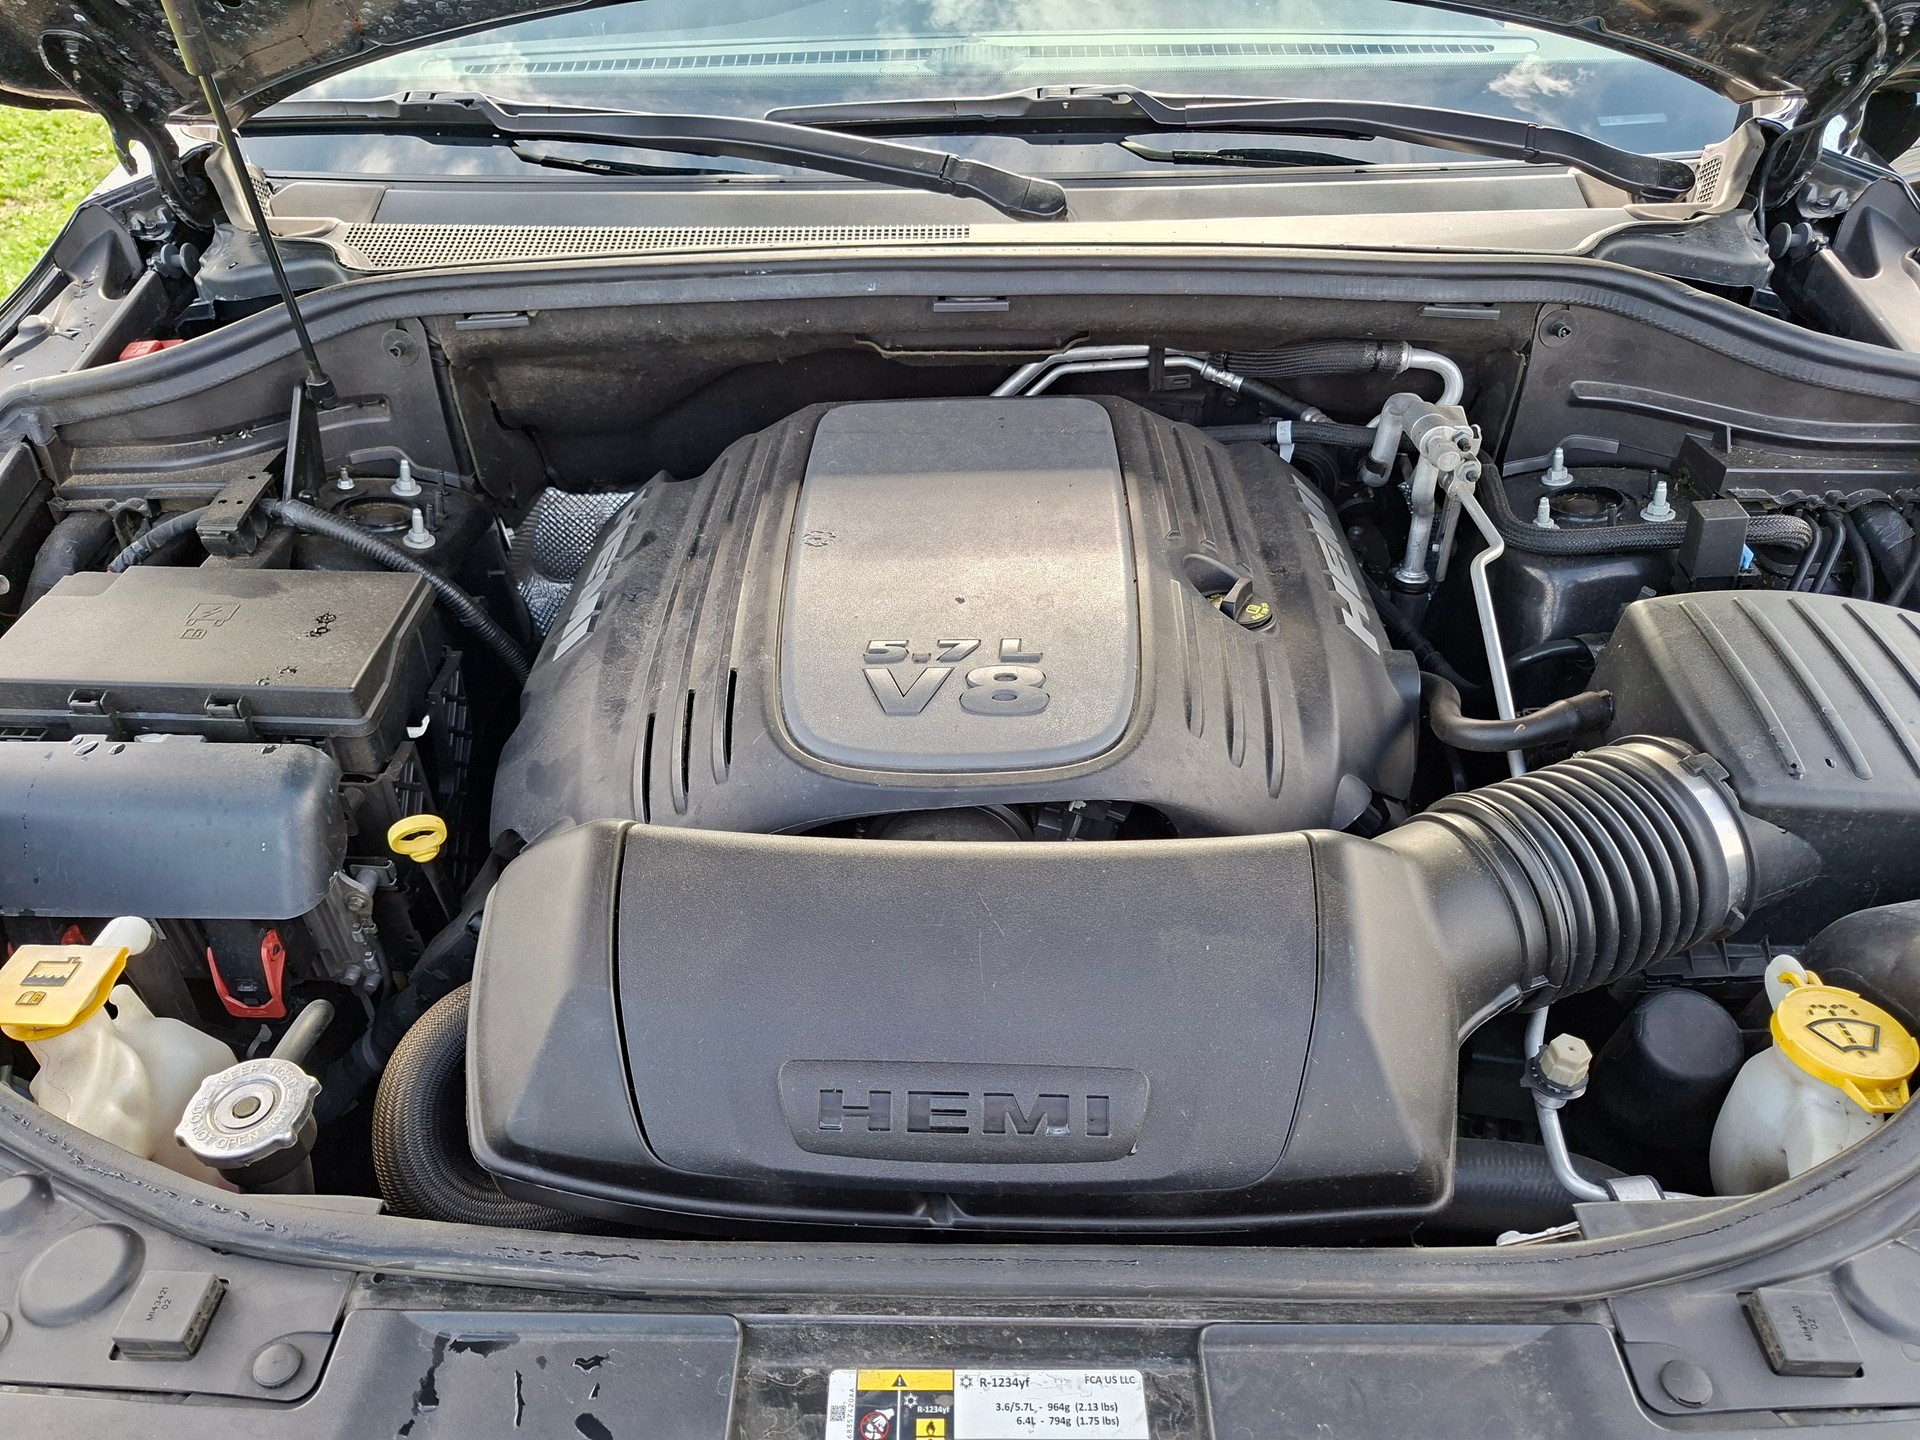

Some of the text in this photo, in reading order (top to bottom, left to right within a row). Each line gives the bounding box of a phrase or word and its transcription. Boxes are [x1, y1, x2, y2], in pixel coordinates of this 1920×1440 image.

[1292, 473, 1380, 656] HEMI
[861, 664, 1051, 715] V8
[217, 1063, 260, 1086] KEEP
[189, 1104, 206, 1125] DO
[818, 1088, 1112, 1137] HEMI
[192, 1124, 214, 1145] NOT
[216, 1130, 261, 1150] OPEN
[144, 1286, 169, 1321] M143421
[161, 1299, 173, 1310] 02
[979, 1377, 1031, 1390] R-1234yf
[1084, 1375, 1136, 1385] FCA US LLC
[995, 1401, 1035, 1413] 3.6/5.7L
[1047, 1402, 1071, 1413] 964g
[1075, 1402, 1099, 1413] (2.13
[1100, 1402, 1118, 1413] lbs)
[1016, 1416, 1036, 1426] 6.4L
[1048, 1416, 1072, 1427] 794g
[1076, 1416, 1100, 1427] (1.75
[1102, 1416, 1119, 1427] lbs)
